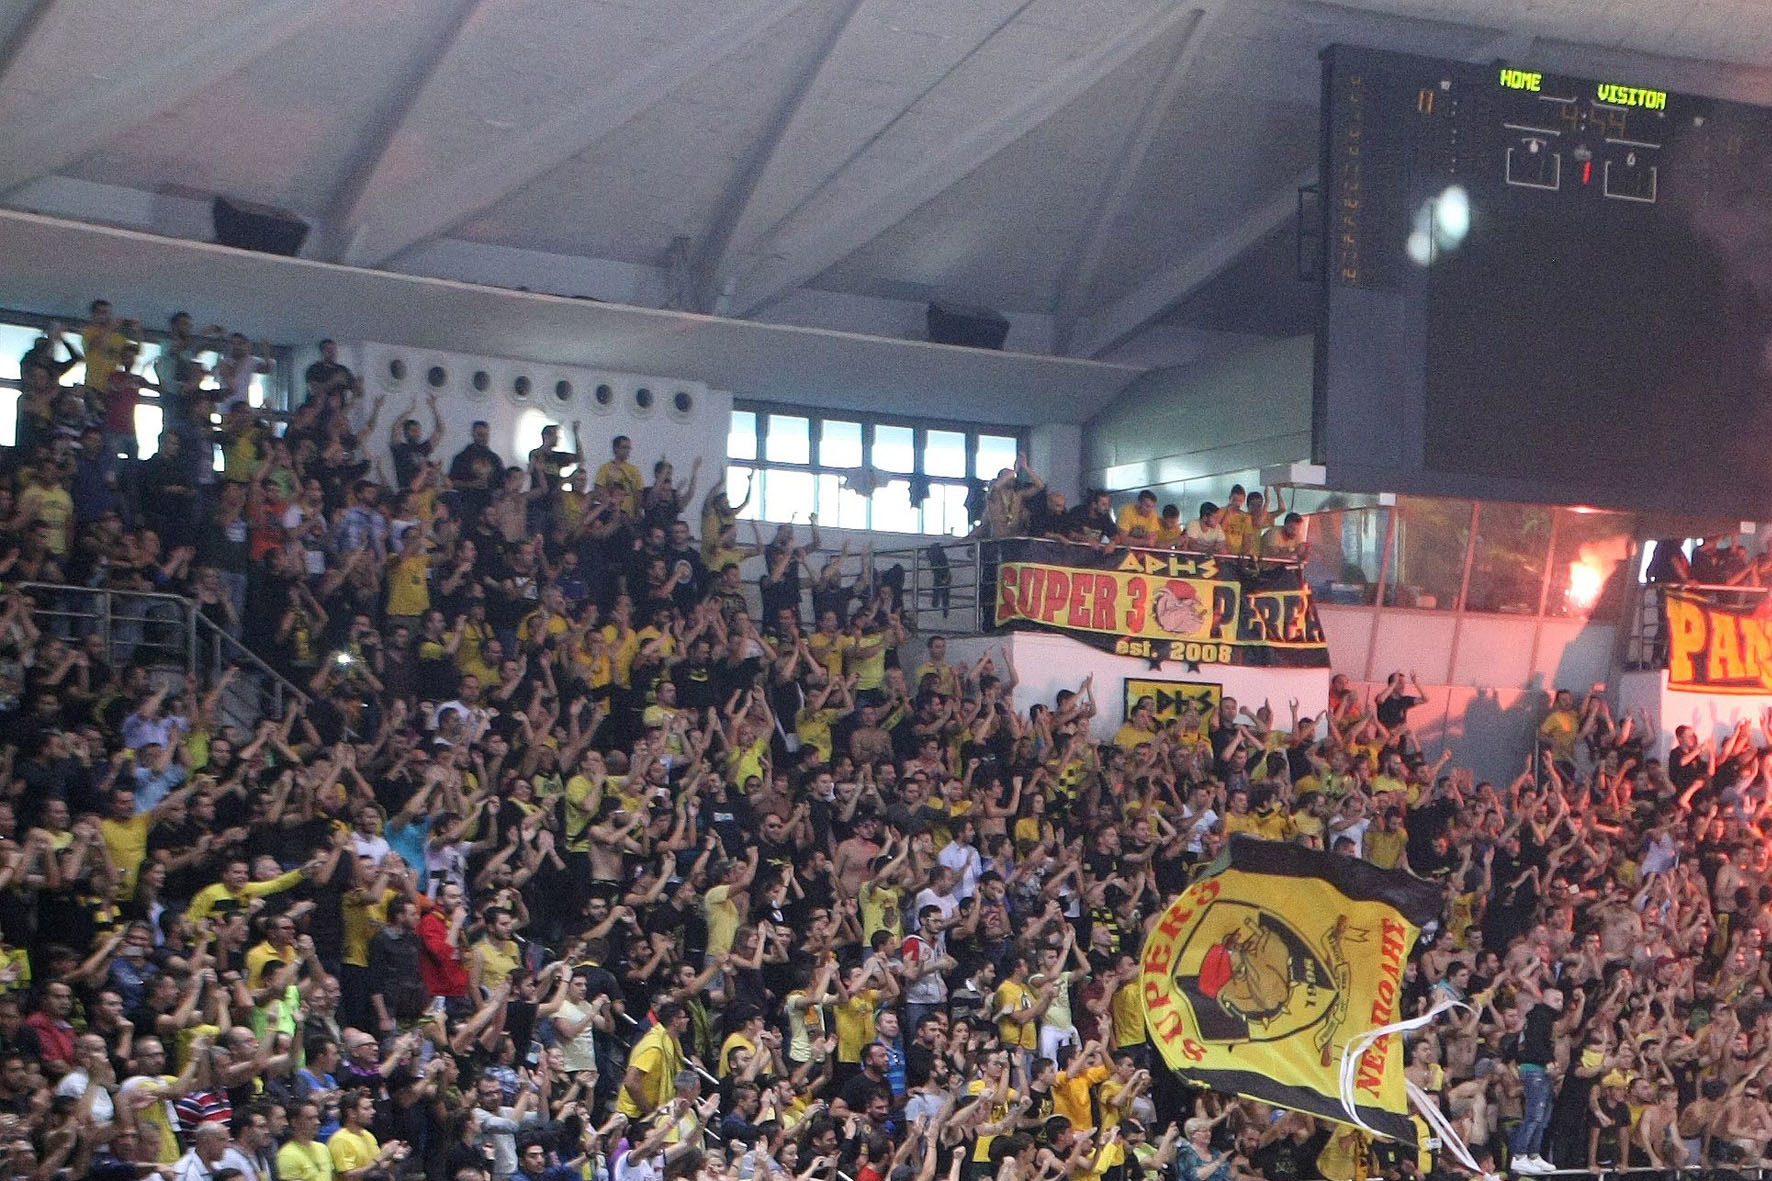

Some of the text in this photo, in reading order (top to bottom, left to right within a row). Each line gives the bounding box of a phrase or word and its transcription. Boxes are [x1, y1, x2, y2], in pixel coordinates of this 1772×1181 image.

[1500, 69, 1542, 92] HOME
[1597, 84, 1667, 110] VISITOR
[997, 565, 1119, 632] SUPER
[1126, 575, 1148, 634] 3
[1169, 641, 1232, 664] 2008
[1144, 903, 1209, 1063] SUPER
